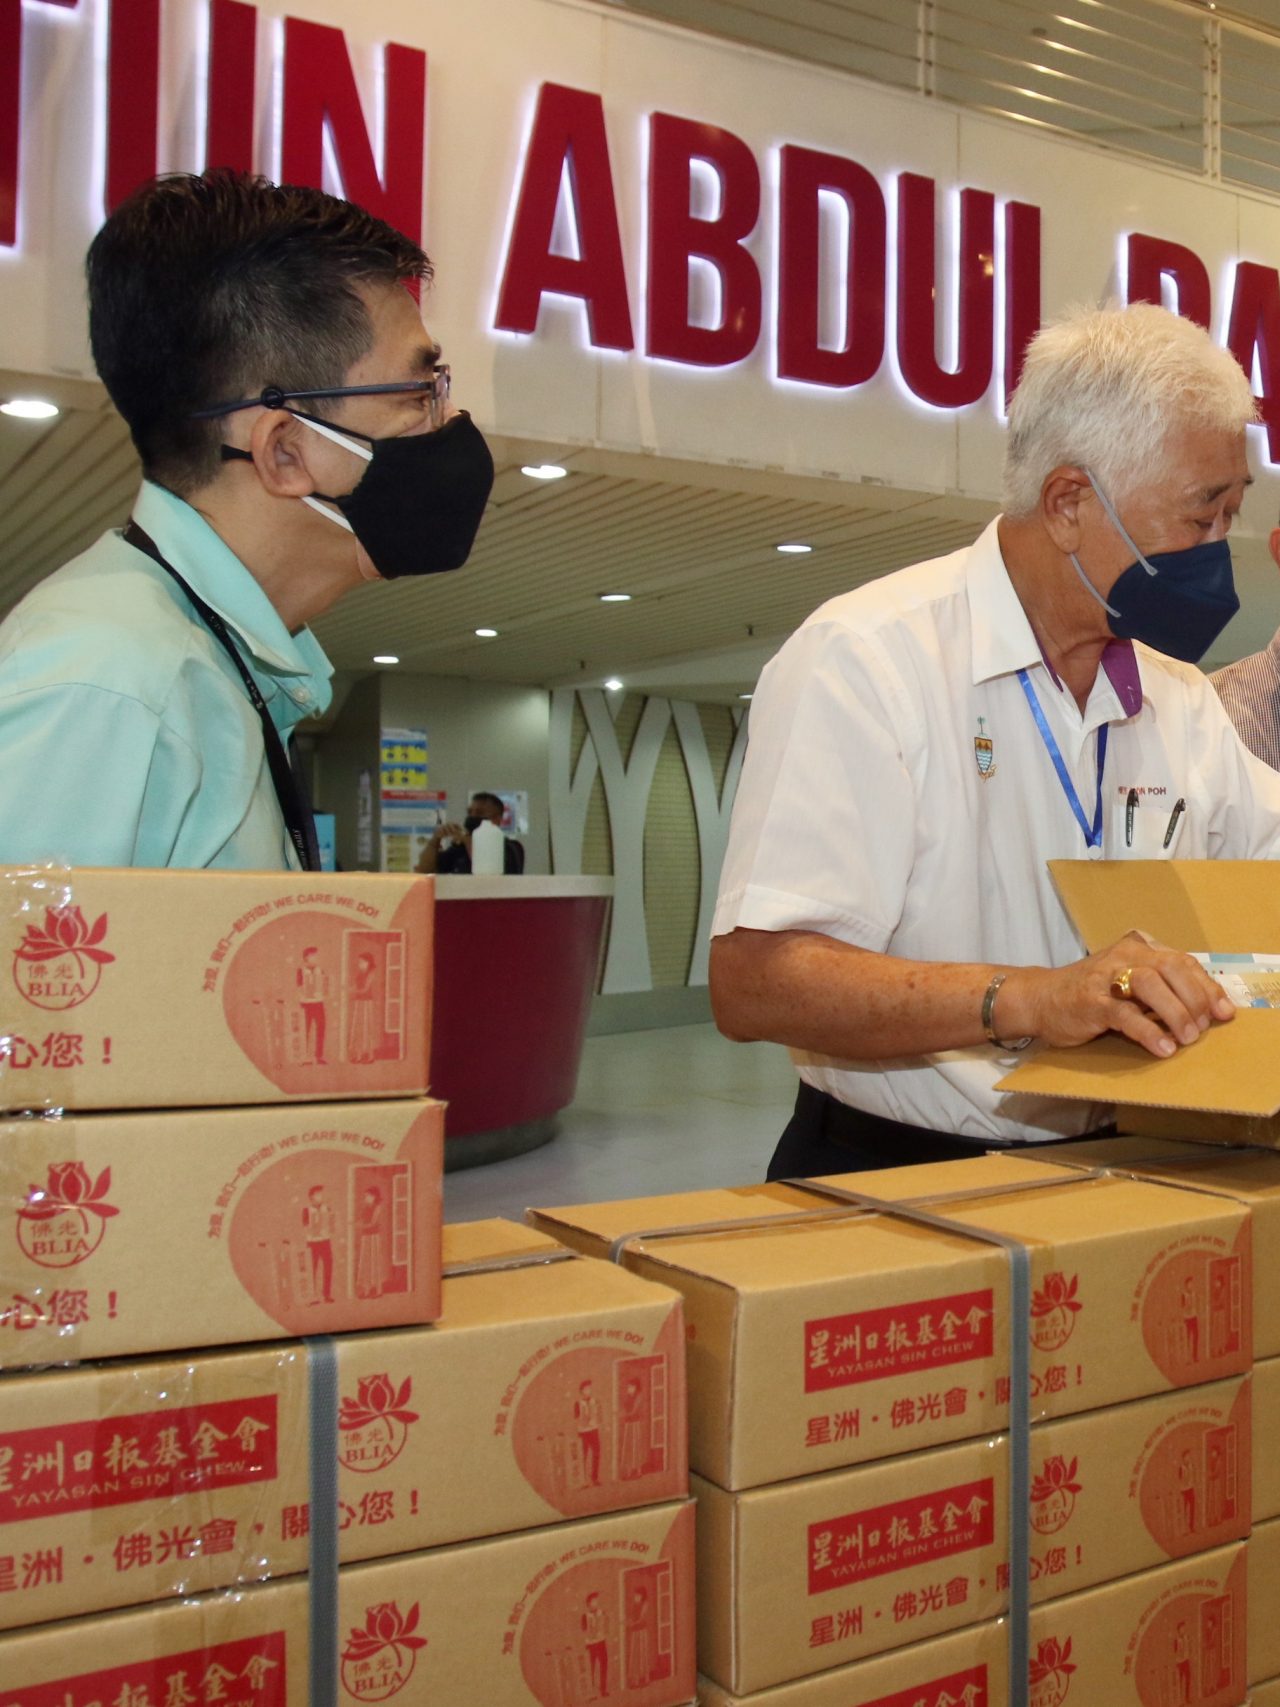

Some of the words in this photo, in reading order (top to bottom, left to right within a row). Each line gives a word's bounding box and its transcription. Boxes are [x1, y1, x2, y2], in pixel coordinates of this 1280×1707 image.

[1147, 787, 1167, 796] POH
[27, 982, 86, 998] BLIA
[32, 1238, 90, 1256] BLIA
[827, 1356, 896, 1378] YAYASAN
[901, 1350, 928, 1363] SIN
[932, 1340, 975, 1358] CHEW
[345, 1444, 395, 1464] BLIA
[14, 1481, 120, 1508] YAYASAN
[130, 1472, 171, 1488] SIN
[180, 1459, 248, 1481] CHEW
[830, 1552, 898, 1578] YAYASAN
[902, 1543, 929, 1558] SIN
[933, 1530, 976, 1550] CHEW
[354, 1671, 403, 1693] BLIA
